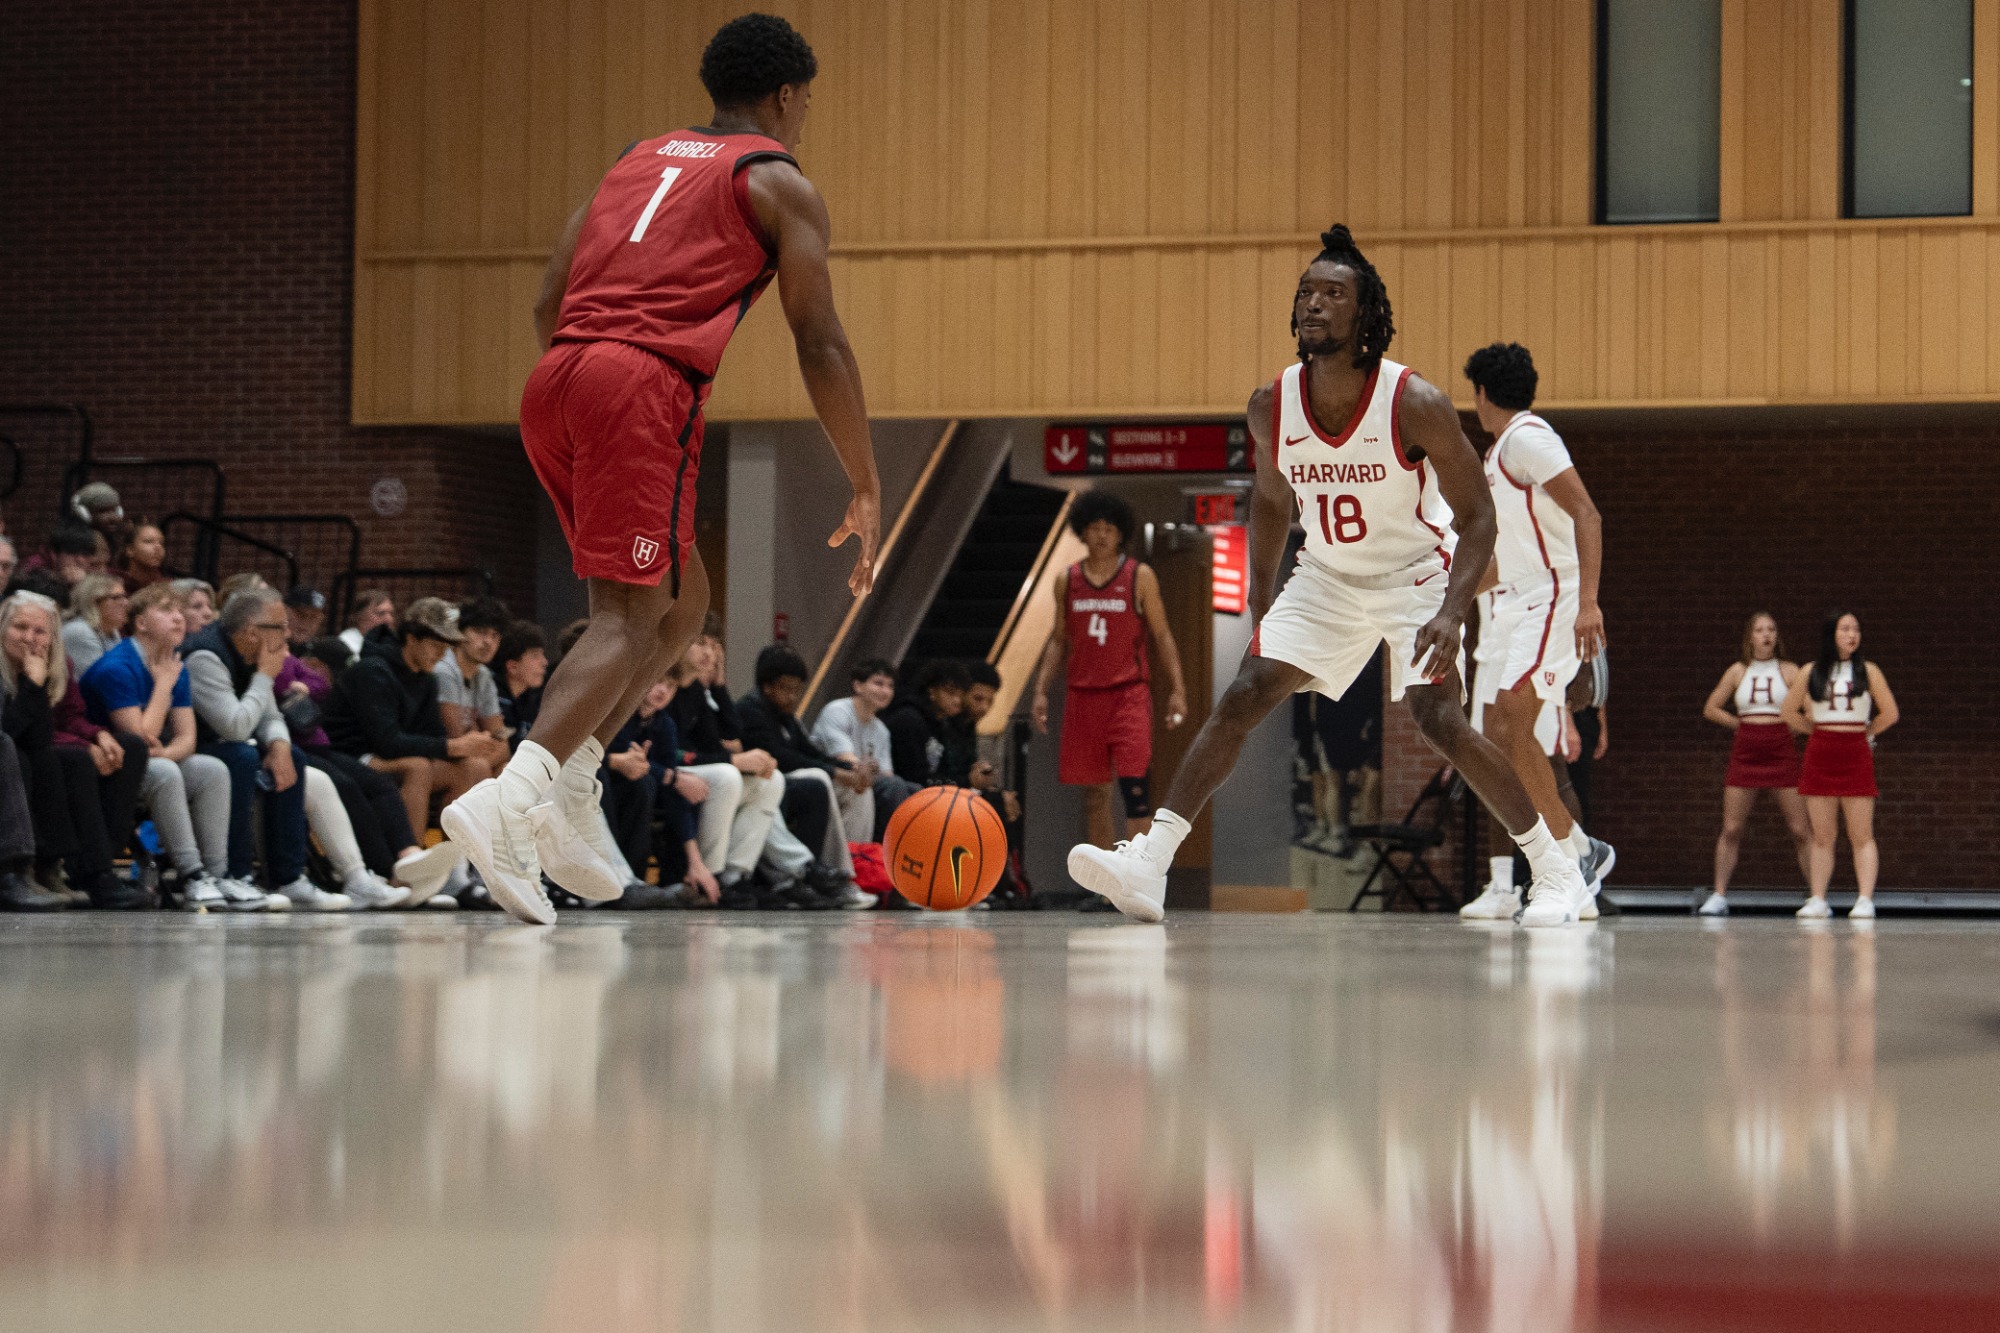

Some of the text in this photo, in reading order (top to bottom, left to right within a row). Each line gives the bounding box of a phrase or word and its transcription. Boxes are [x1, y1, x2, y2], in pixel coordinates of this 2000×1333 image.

[656, 139, 726, 158] BURRELL
[629, 166, 683, 243] 1
[1290, 463, 1387, 484] HARVARD
[1317, 494, 1367, 545] 18
[637, 541, 653, 561] H
[1072, 599, 1127, 612] HARVARD
[1088, 613, 1108, 646] 4
[1749, 676, 1774, 704] H
[1828, 680, 1854, 711] H
[901, 854, 924, 879] H
